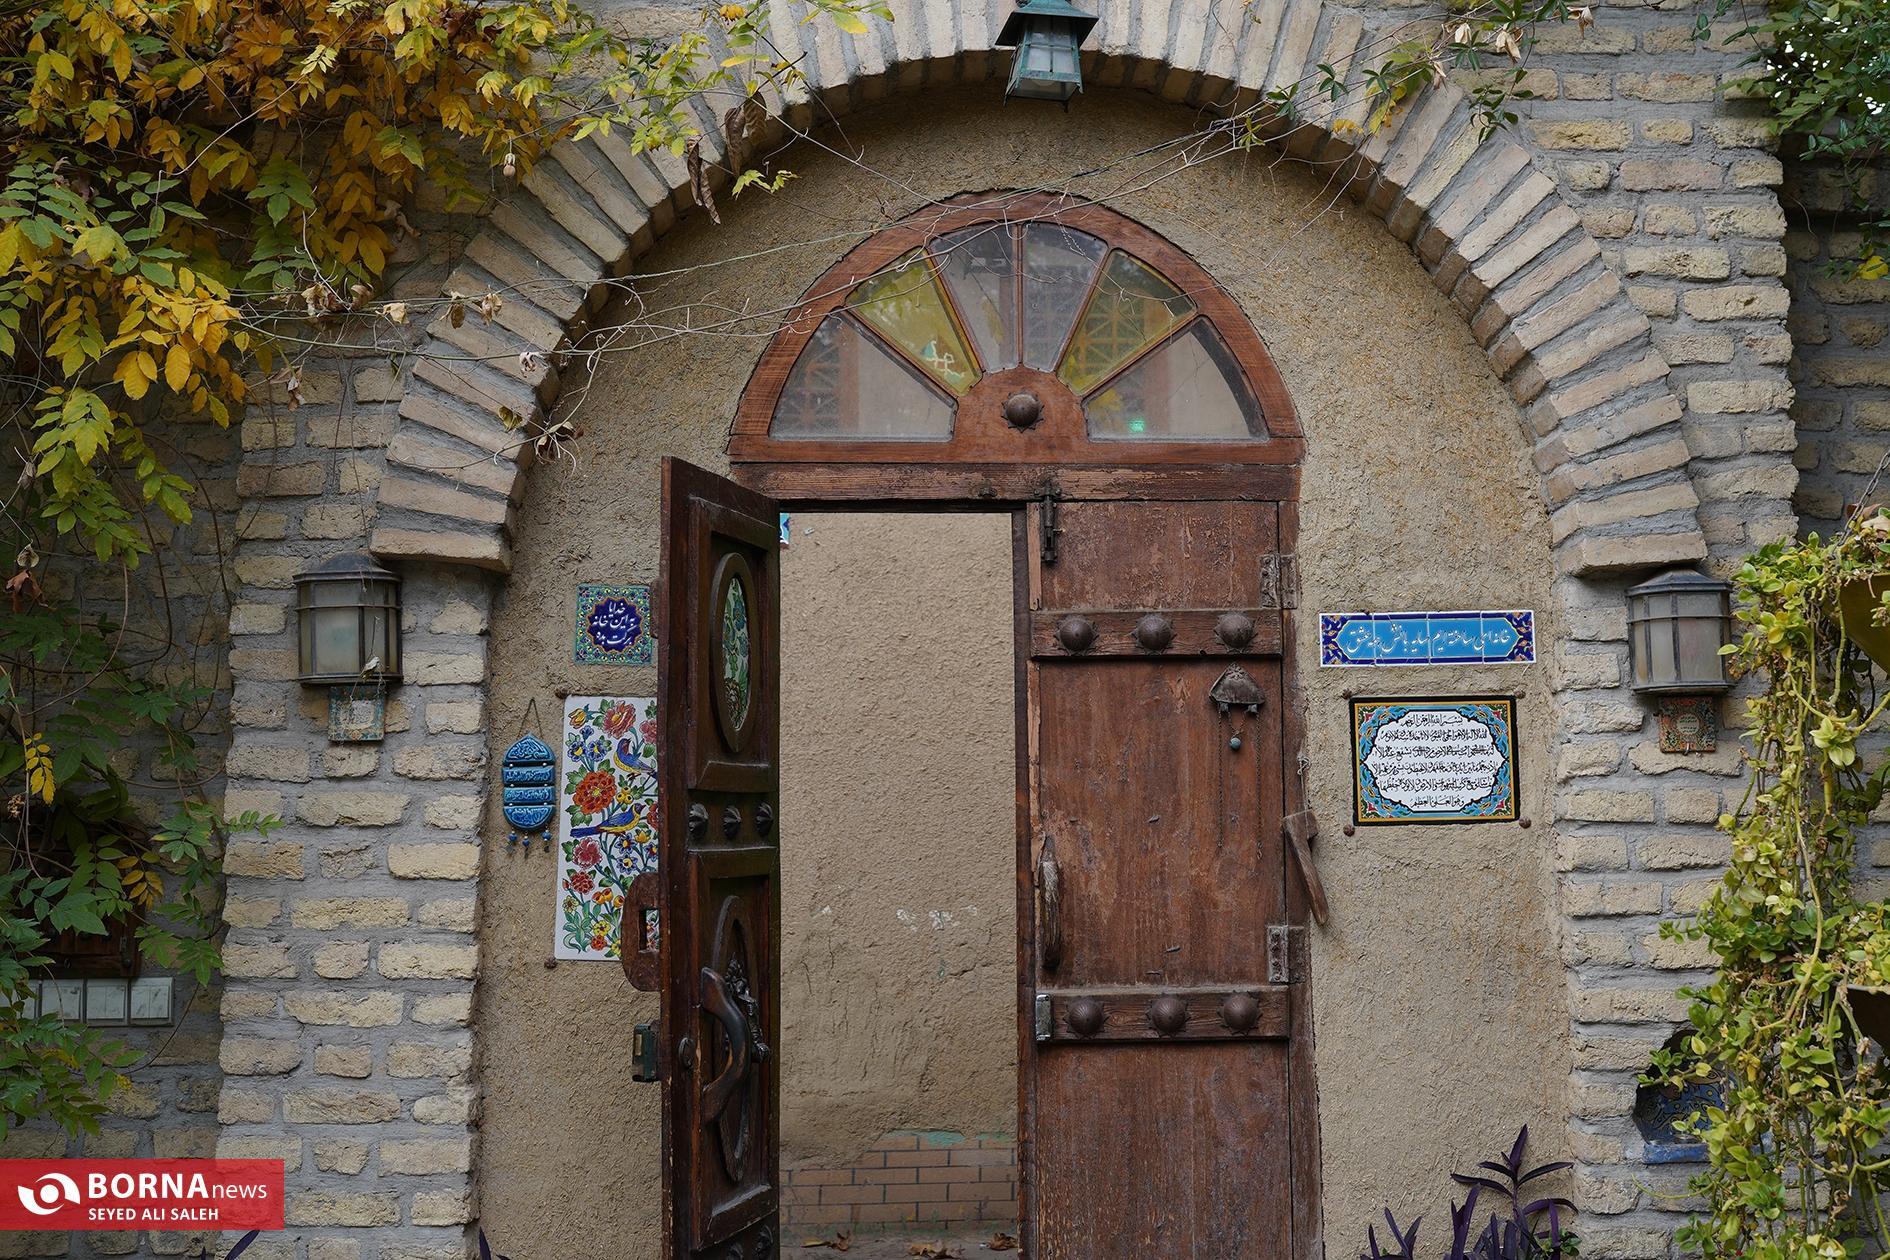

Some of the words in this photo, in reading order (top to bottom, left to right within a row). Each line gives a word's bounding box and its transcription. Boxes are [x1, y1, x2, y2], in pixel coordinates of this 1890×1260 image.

[608, 601, 626, 618] خدایا
[592, 614, 609, 627] خانه
[1346, 626, 1372, 653] عشق
